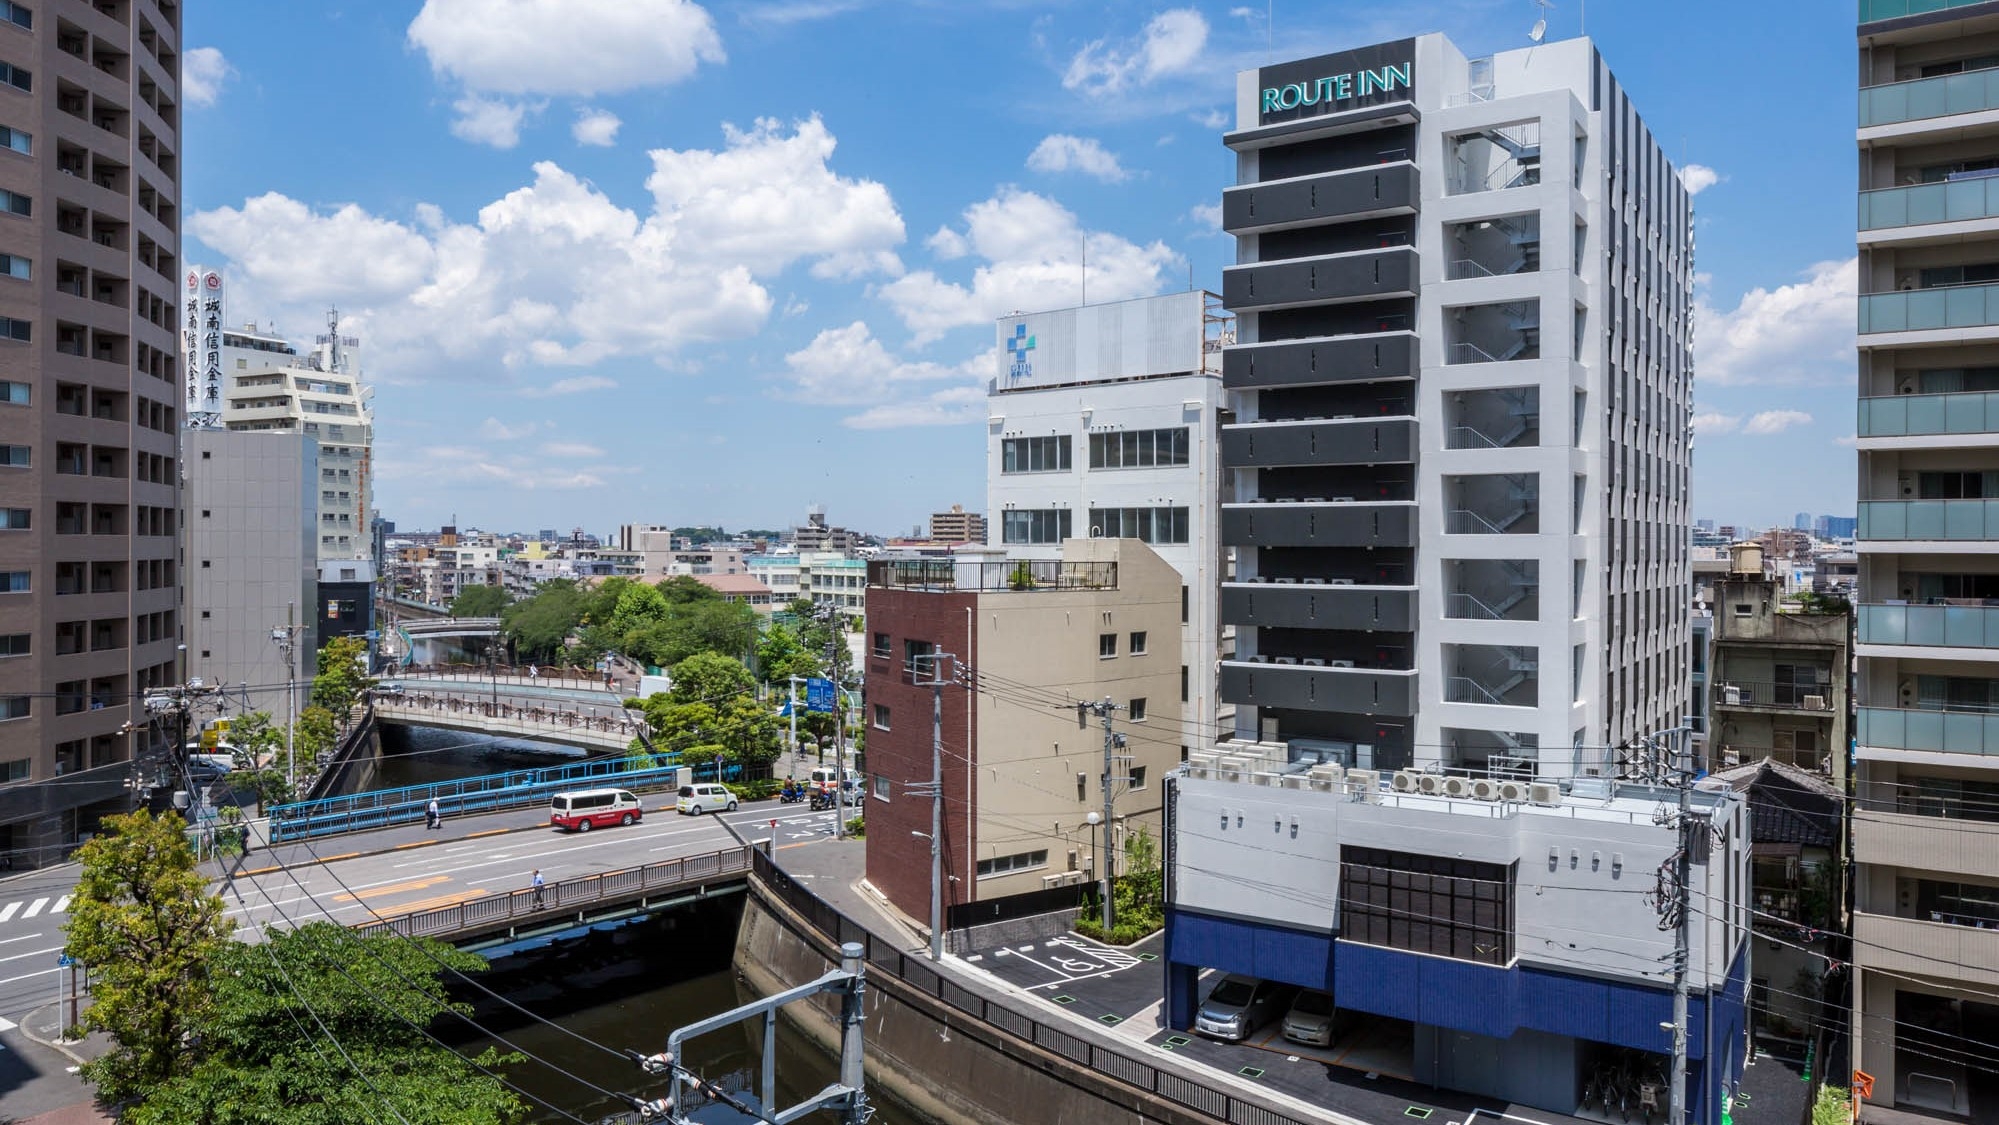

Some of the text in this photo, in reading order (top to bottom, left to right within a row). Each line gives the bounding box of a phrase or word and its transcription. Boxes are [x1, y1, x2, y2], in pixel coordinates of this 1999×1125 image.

[1262, 62, 1411, 114] ROUTE INN
[187, 297, 199, 406] 城南信用金庫
[205, 298, 222, 404] 城南信用金庫
